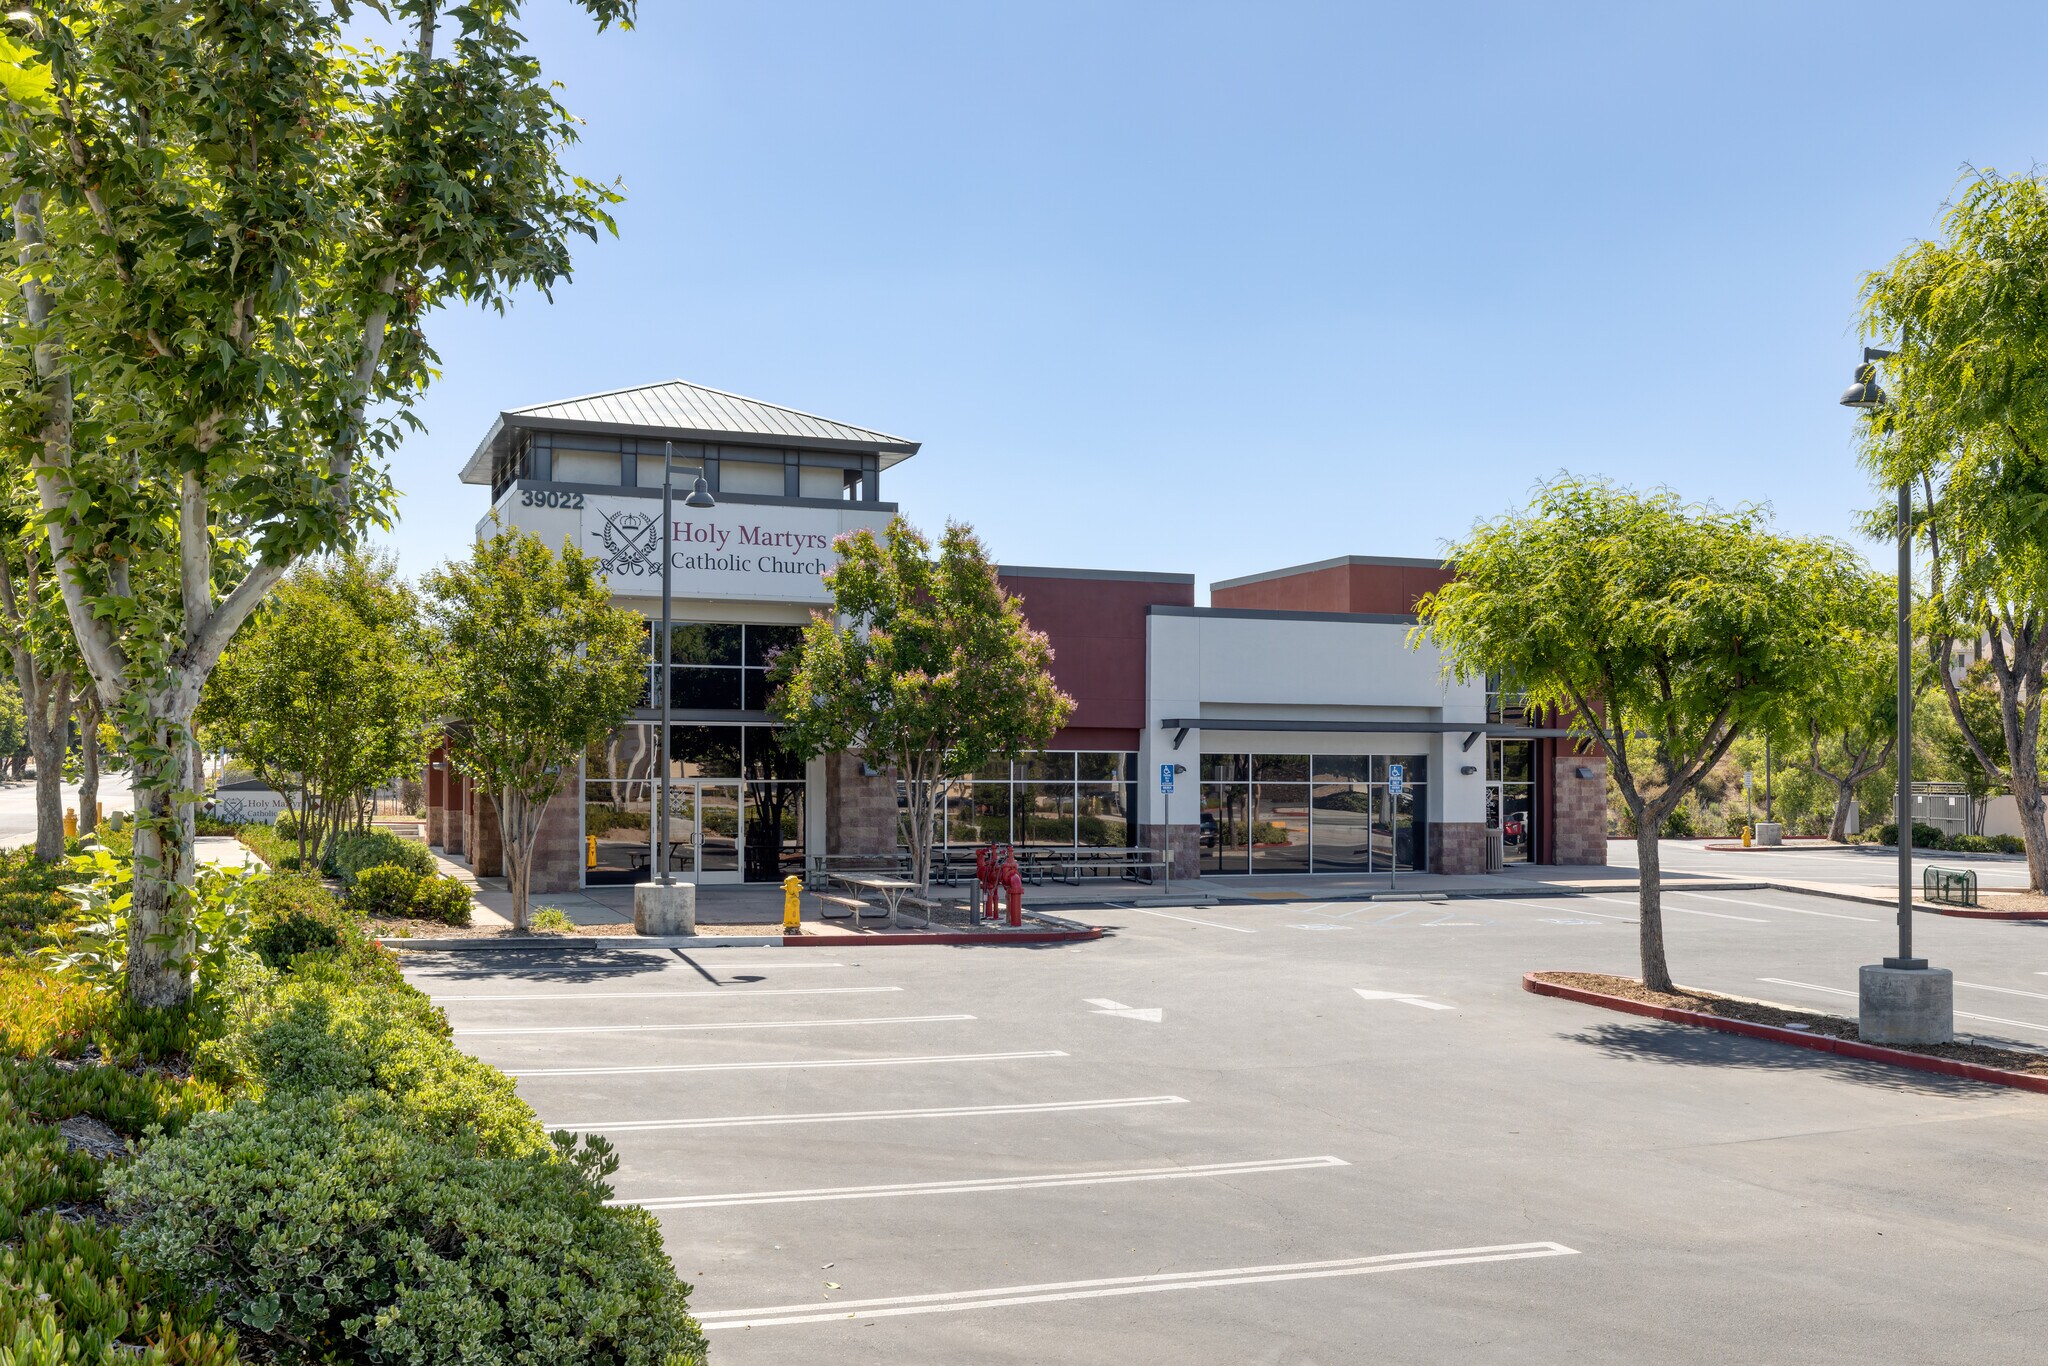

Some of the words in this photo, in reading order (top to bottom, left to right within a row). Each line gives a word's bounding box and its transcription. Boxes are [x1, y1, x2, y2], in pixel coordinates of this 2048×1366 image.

[521, 490, 584, 509] 39022
[672, 522, 730, 551] Holy
[738, 525, 827, 555] Martyrs
[671, 552, 751, 571] Catholic
[758, 556, 826, 575] Church
[248, 800, 269, 810] Holy
